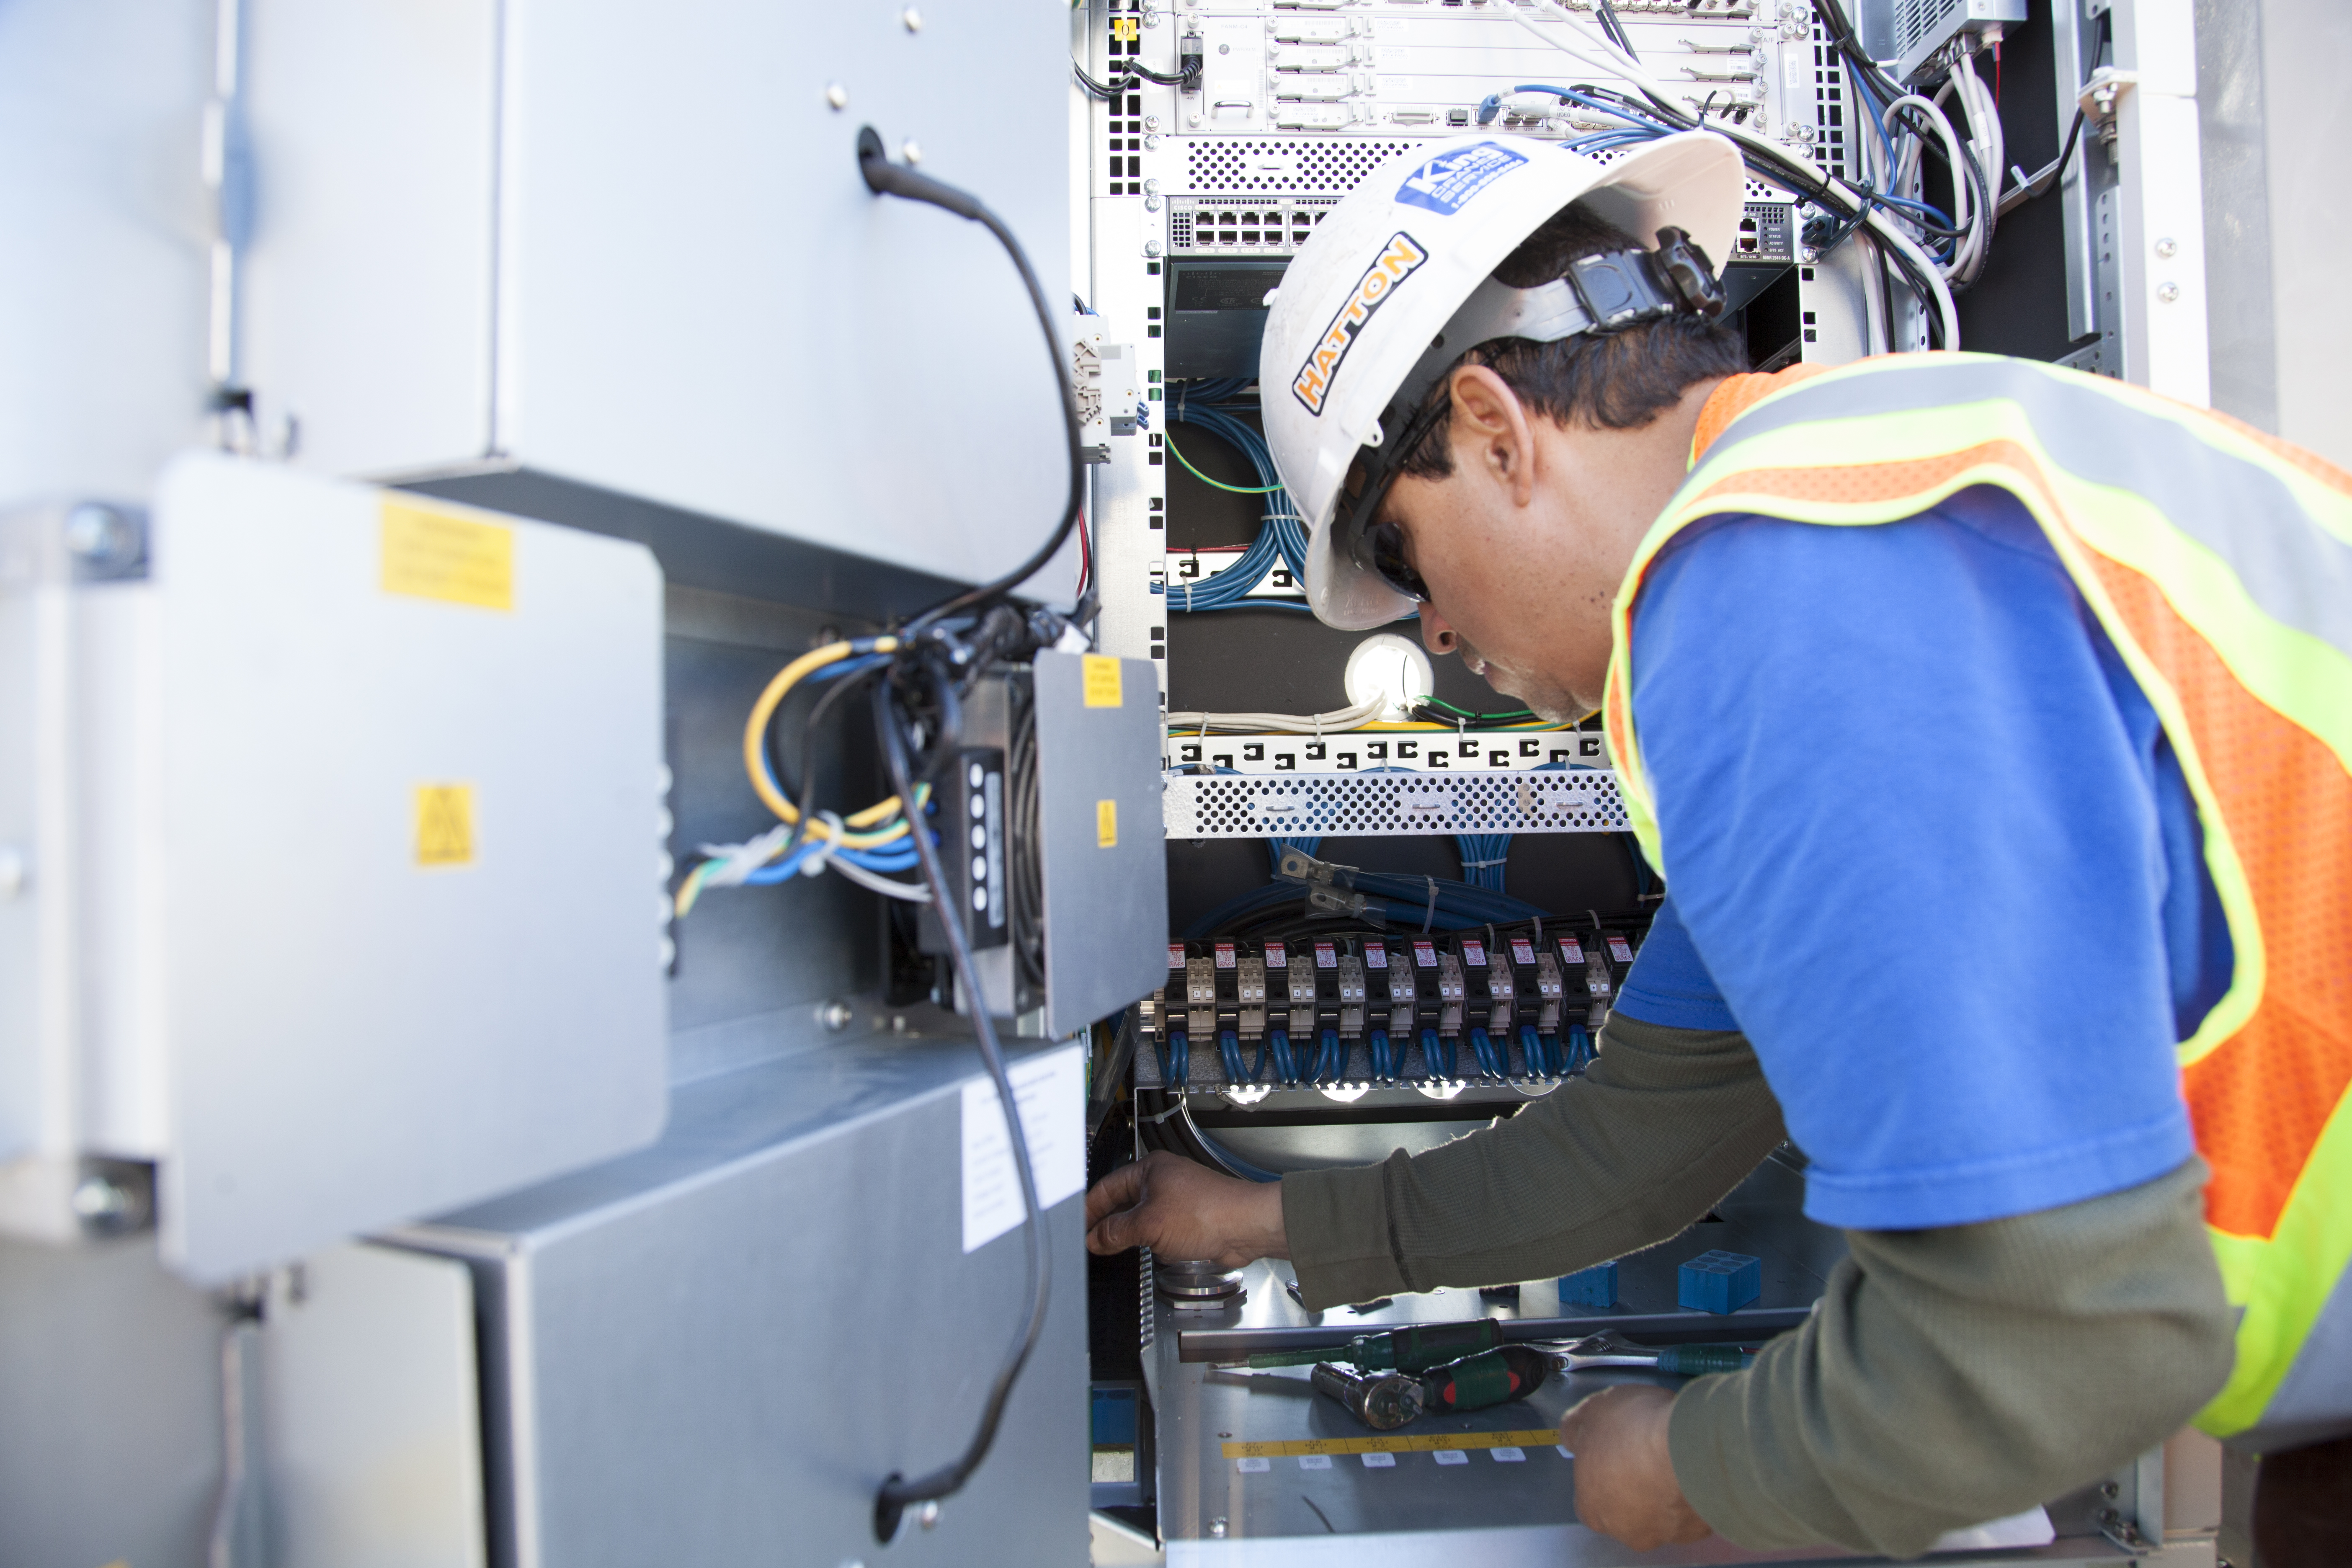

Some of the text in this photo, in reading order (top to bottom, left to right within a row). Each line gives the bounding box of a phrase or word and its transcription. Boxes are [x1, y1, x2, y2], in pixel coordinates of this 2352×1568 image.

[1406, 147, 1504, 194] King
[1924, 136, 1947, 158] COMPUTER
[1431, 157, 1491, 199] CRANE
[1440, 155, 1512, 204] SERVICE
[1295, 239, 1418, 406] HATTON
